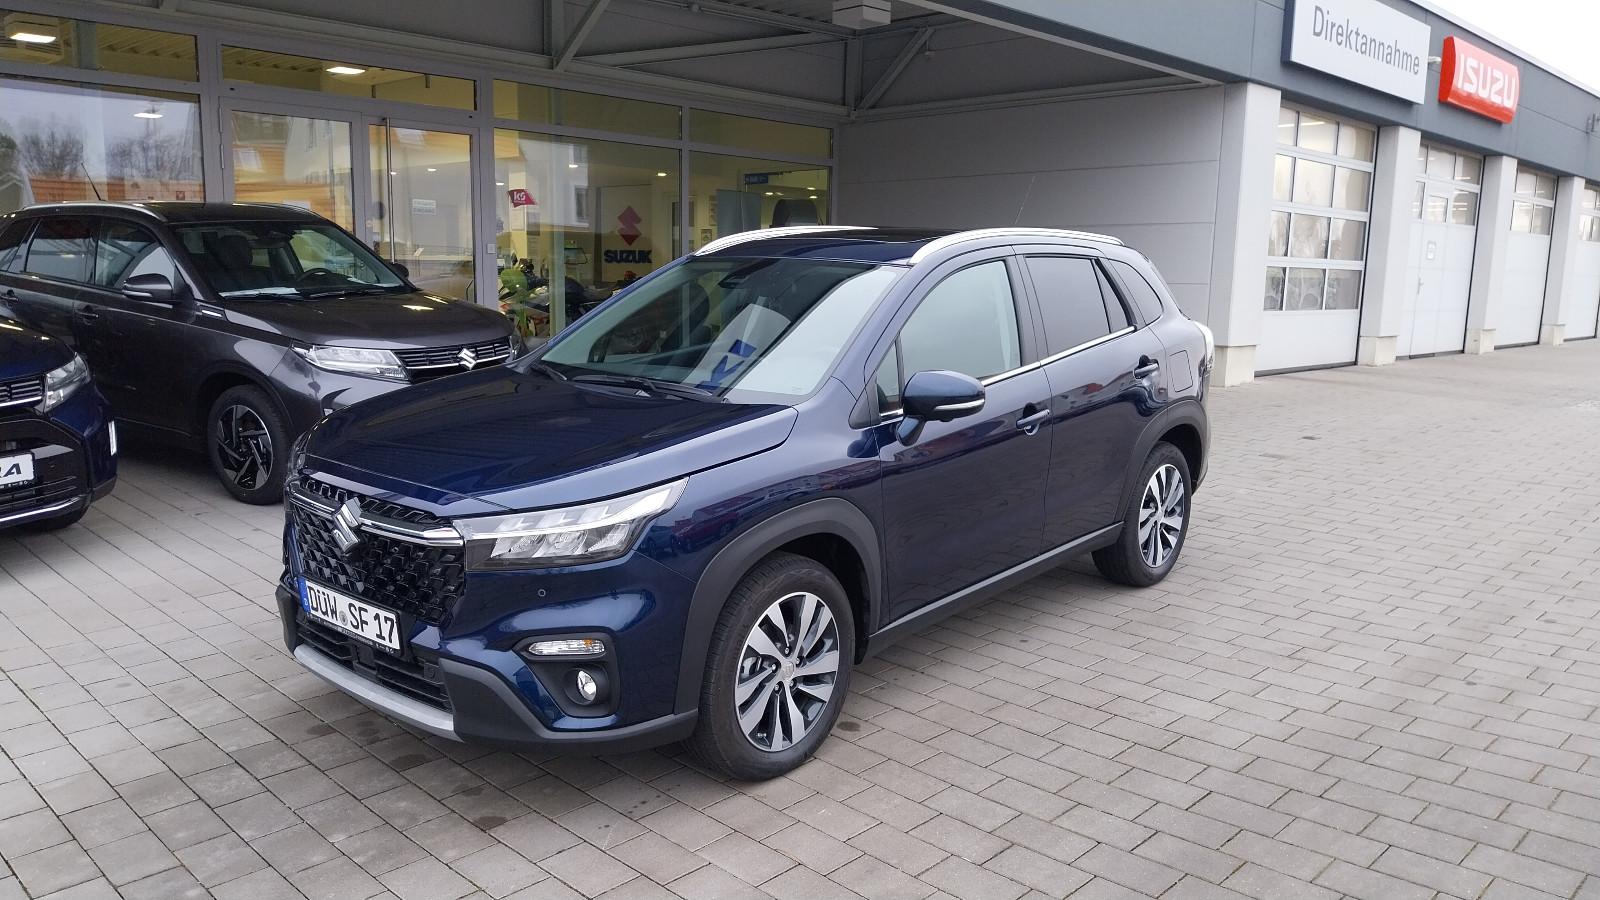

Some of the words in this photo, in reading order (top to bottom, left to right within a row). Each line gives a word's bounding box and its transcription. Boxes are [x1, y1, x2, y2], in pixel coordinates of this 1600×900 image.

[1312, 5, 1420, 75] Direktannahme
[1457, 53, 1516, 108] ISUZU
[308, 585, 338, 622] DÜW
[348, 602, 369, 633] SF
[373, 612, 395, 644] 17
